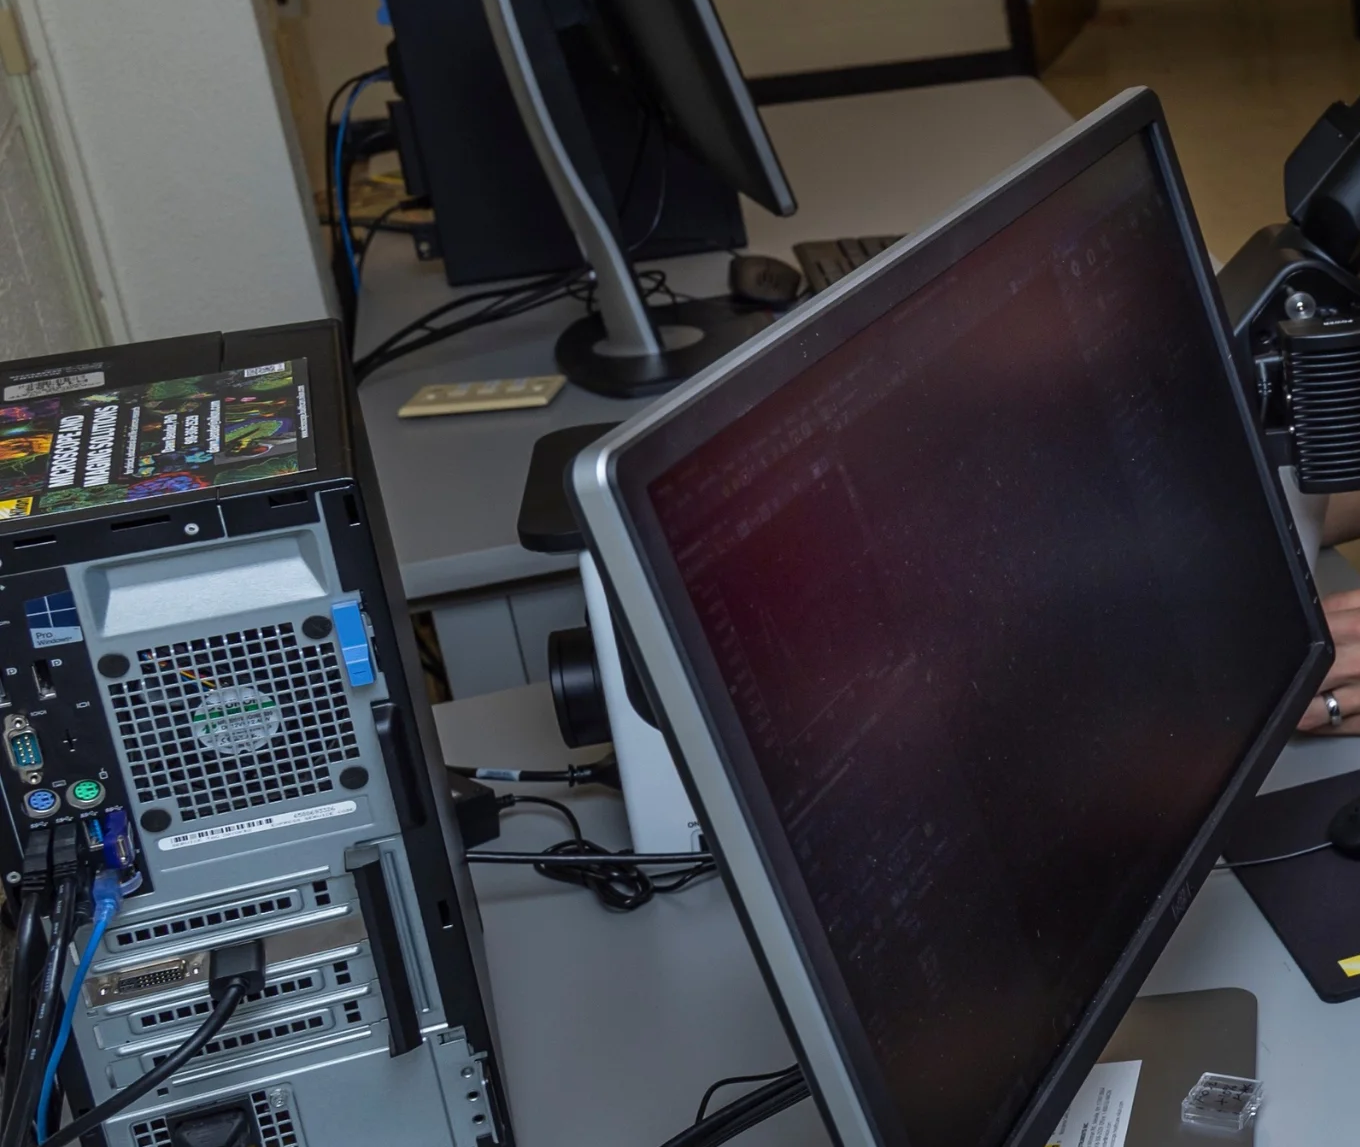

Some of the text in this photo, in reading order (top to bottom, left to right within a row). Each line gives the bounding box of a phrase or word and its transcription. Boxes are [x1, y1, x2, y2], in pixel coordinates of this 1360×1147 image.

[48, 414, 84, 487] MICROSCOPE AND
[84, 404, 117, 487] IMAGING SOLUTIONS
